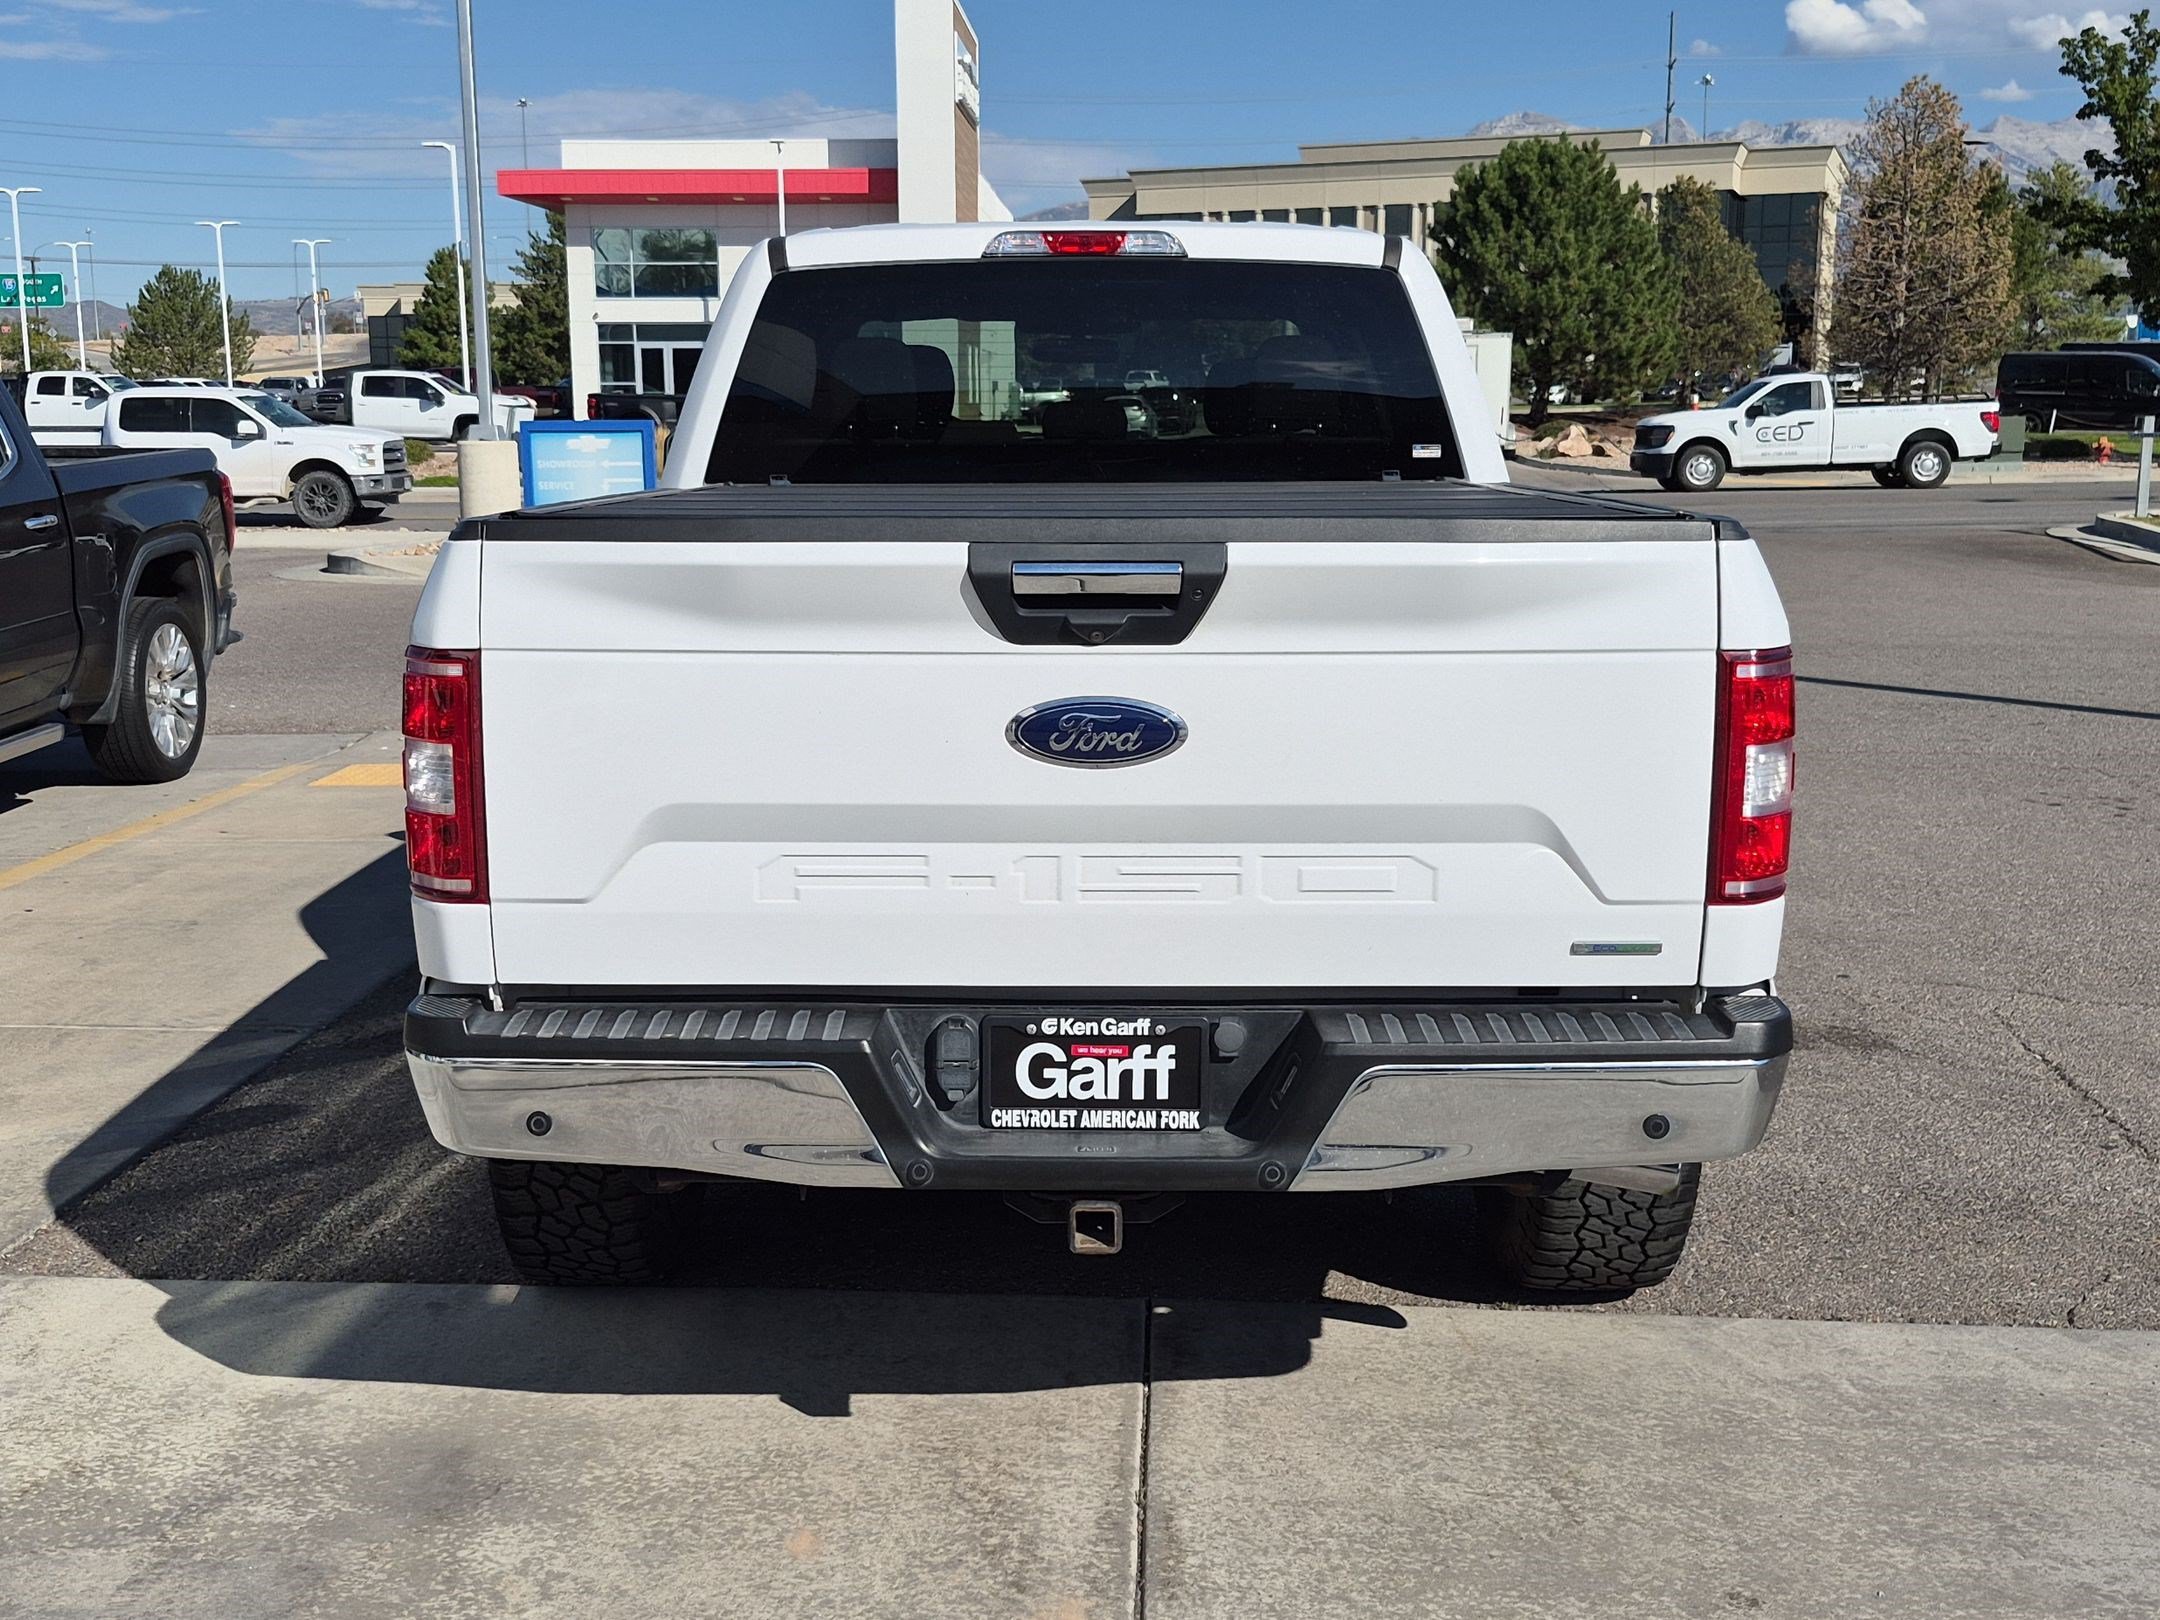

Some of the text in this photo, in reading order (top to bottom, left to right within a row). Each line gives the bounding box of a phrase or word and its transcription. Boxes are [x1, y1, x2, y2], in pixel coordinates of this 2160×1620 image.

[537, 480, 575, 490] SERVICE
[1049, 712, 1145, 752] Ford
[756, 854, 1439, 904] F-150
[1060, 1018, 1099, 1036] Ken
[1100, 1018, 1151, 1036] Garff
[1090, 1046, 1106, 1054] hear
[1108, 1047, 1123, 1055] you
[1015, 1042, 1176, 1100] Garff
[991, 1109, 1200, 1130] CHEVROLET AMERICAN FORK
